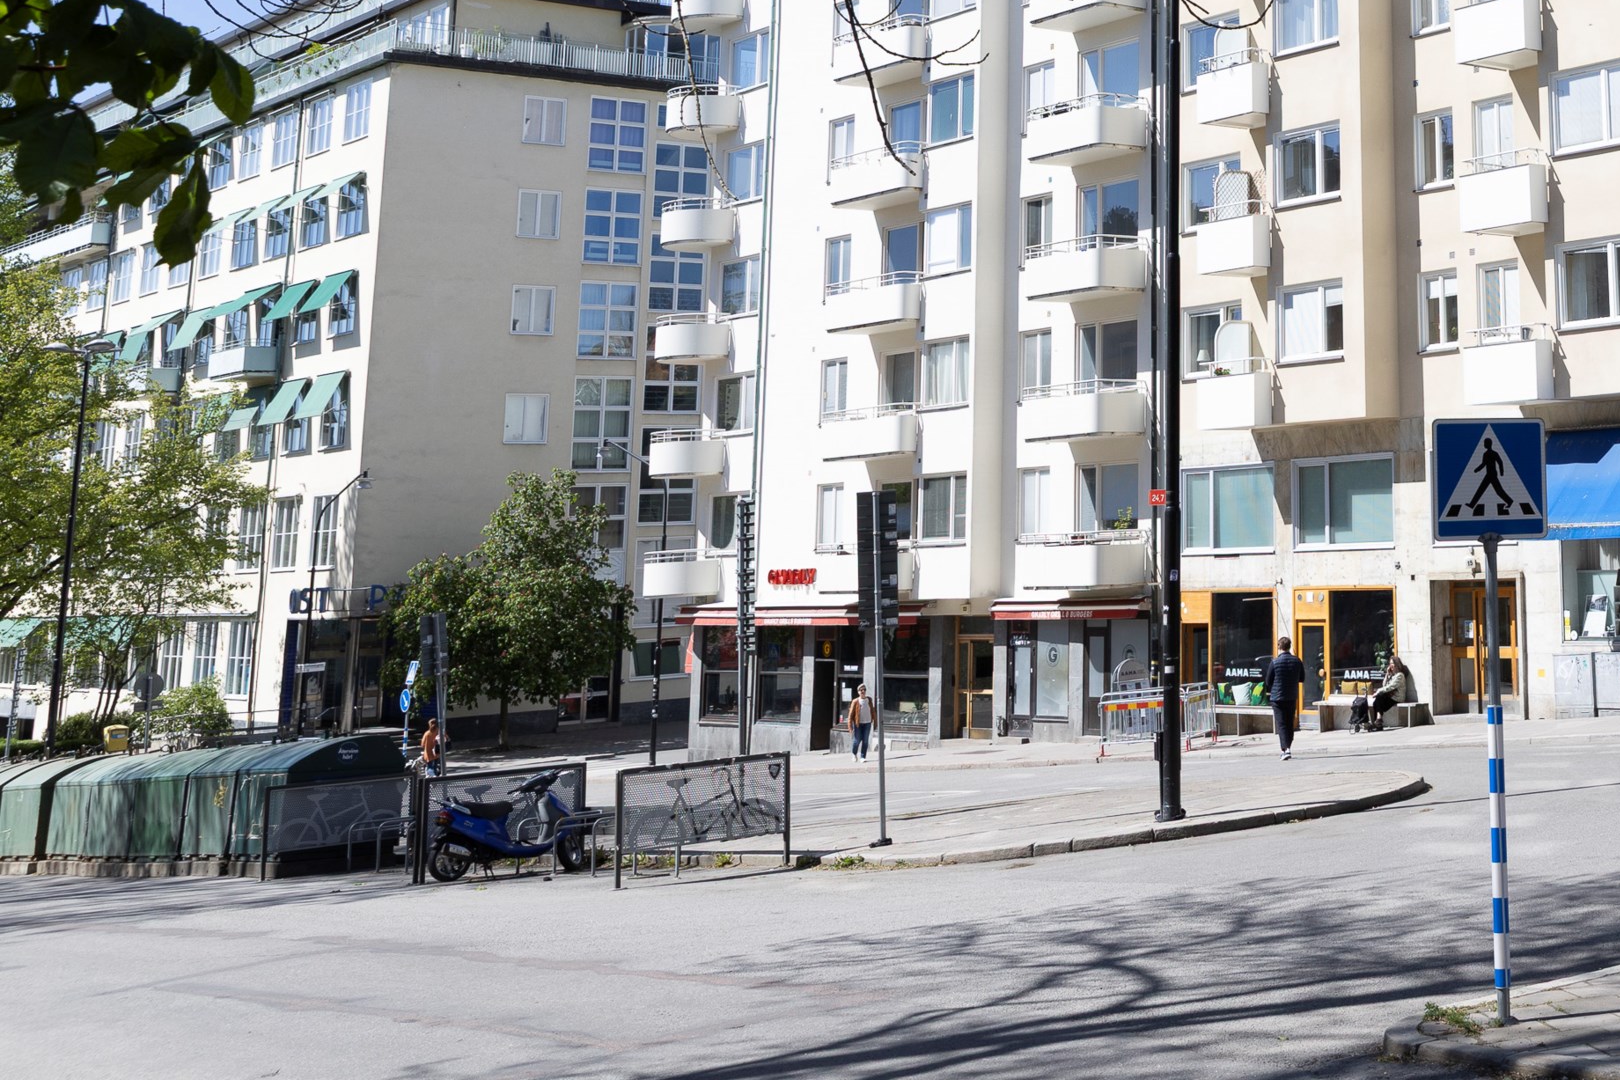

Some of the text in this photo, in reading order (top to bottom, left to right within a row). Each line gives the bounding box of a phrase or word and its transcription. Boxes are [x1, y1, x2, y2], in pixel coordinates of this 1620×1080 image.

[1048, 647, 1058, 663] G
[1225, 667, 1249, 677] AAMA
[1343, 669, 1370, 679] AAMA
